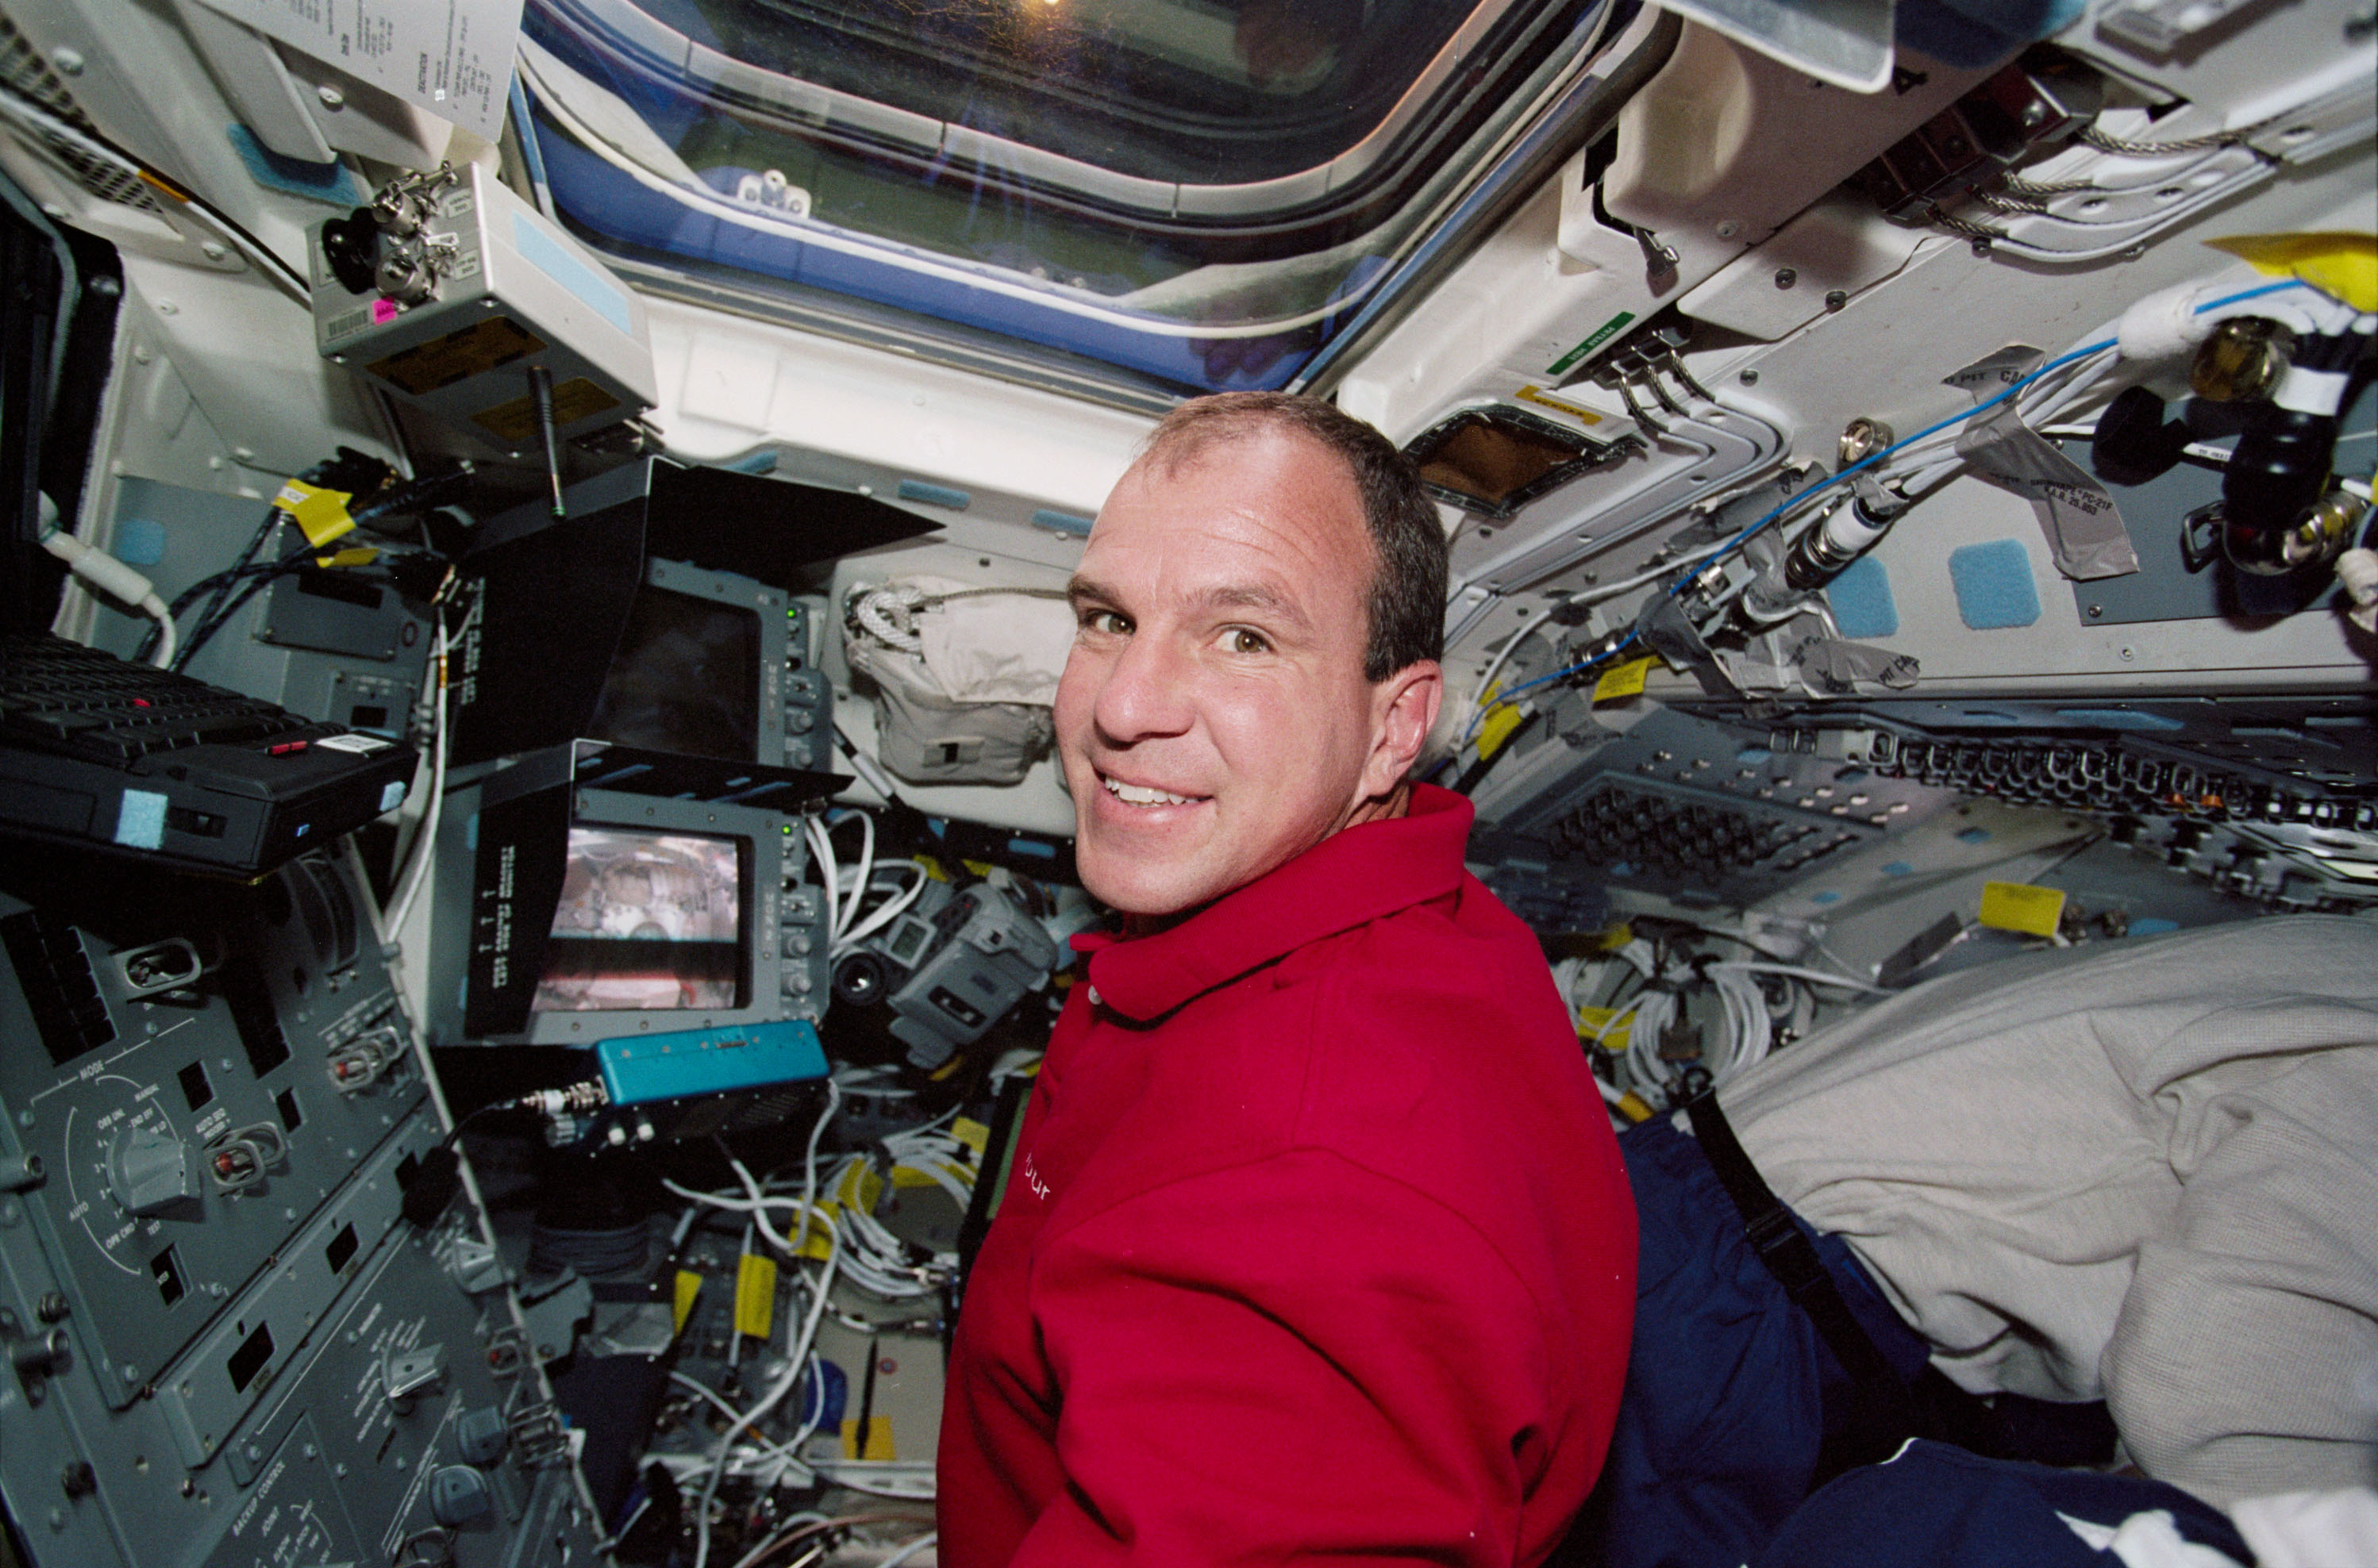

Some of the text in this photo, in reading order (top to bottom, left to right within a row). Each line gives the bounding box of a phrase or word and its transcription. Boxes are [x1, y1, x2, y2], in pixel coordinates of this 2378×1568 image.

[502, 846, 514, 897] MONITOR
[498, 957, 507, 986] LEFT
[79, 1059, 105, 1080] MODE
[195, 1117, 214, 1133] AUTO
[1024, 1152, 1051, 1200] our
[69, 1202, 89, 1220] AUTO
[106, 1223, 135, 1249] OPR CMD
[147, 1221, 161, 1236] TEST
[233, 1461, 285, 1536] BACKUP CONTROL
[262, 1506, 279, 1536] JOINT
